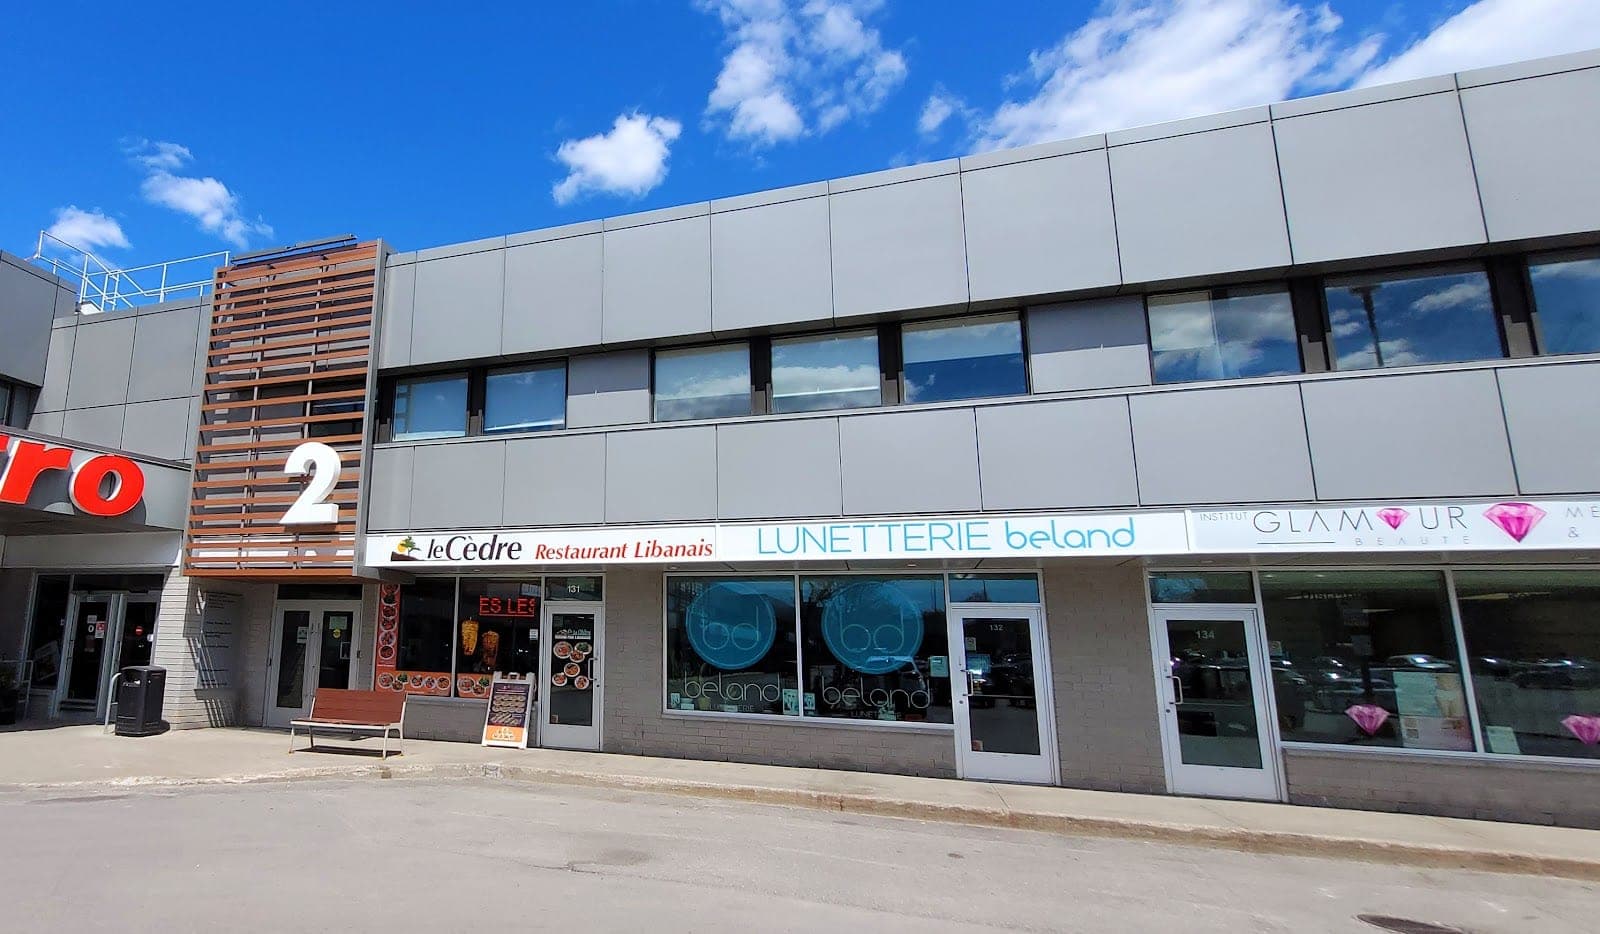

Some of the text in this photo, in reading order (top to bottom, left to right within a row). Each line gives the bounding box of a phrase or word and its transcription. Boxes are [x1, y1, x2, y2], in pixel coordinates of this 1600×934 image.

[0, 434, 145, 517] ro
[279, 441, 341, 524] 2
[1200, 511, 1248, 521] INSTITUT
[1253, 506, 1467, 533] GLAMUR
[535, 538, 713, 560] Restaurant Libanais
[757, 516, 1135, 554] LUNETTERIE beland
[568, 585, 580, 593] 131
[1195, 630, 1215, 639] 134
[684, 670, 780, 702] beland
[822, 675, 930, 708] beland
